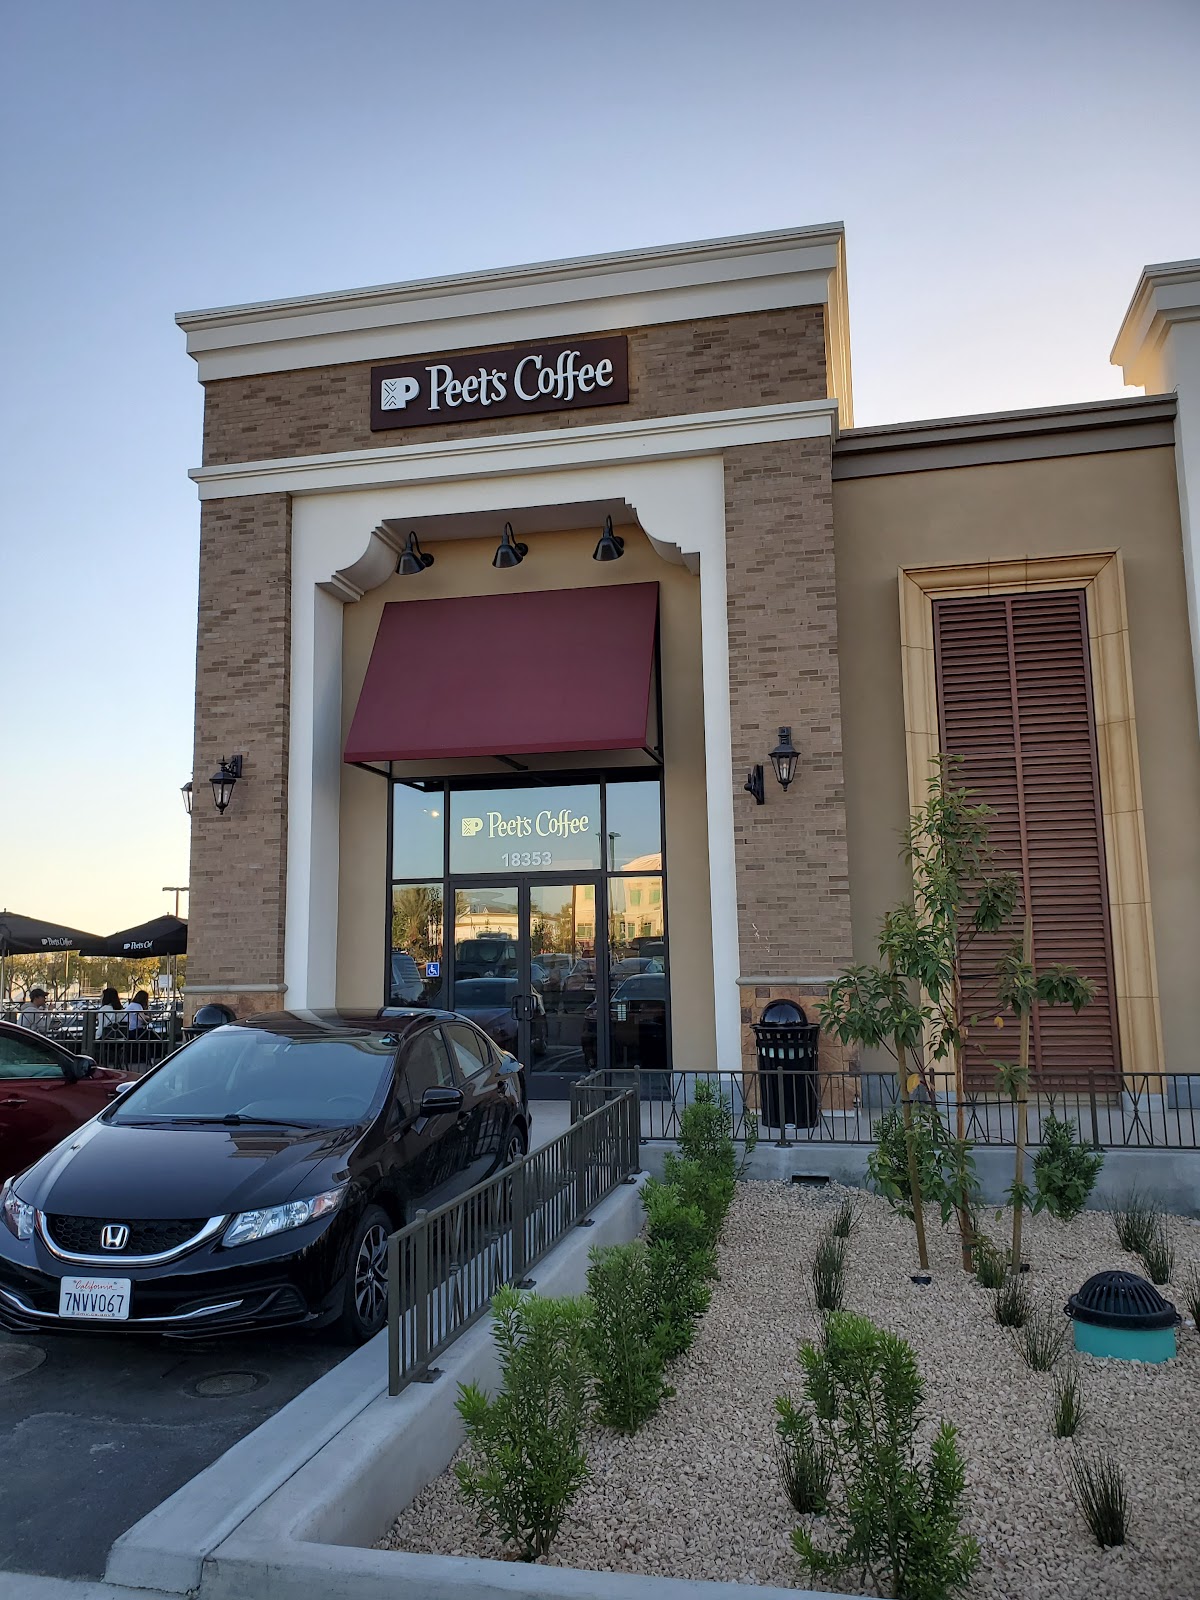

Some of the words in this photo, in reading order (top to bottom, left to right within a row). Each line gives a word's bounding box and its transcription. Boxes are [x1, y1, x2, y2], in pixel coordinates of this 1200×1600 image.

[425, 364, 507, 411] Peet's
[514, 350, 614, 402] Coffee
[486, 811, 532, 838] Peet's
[535, 809, 589, 838] Coffee
[501, 851, 552, 867] 18353
[75, 1280, 113, 1292] California
[65, 1292, 125, 1313] 7NVV067
